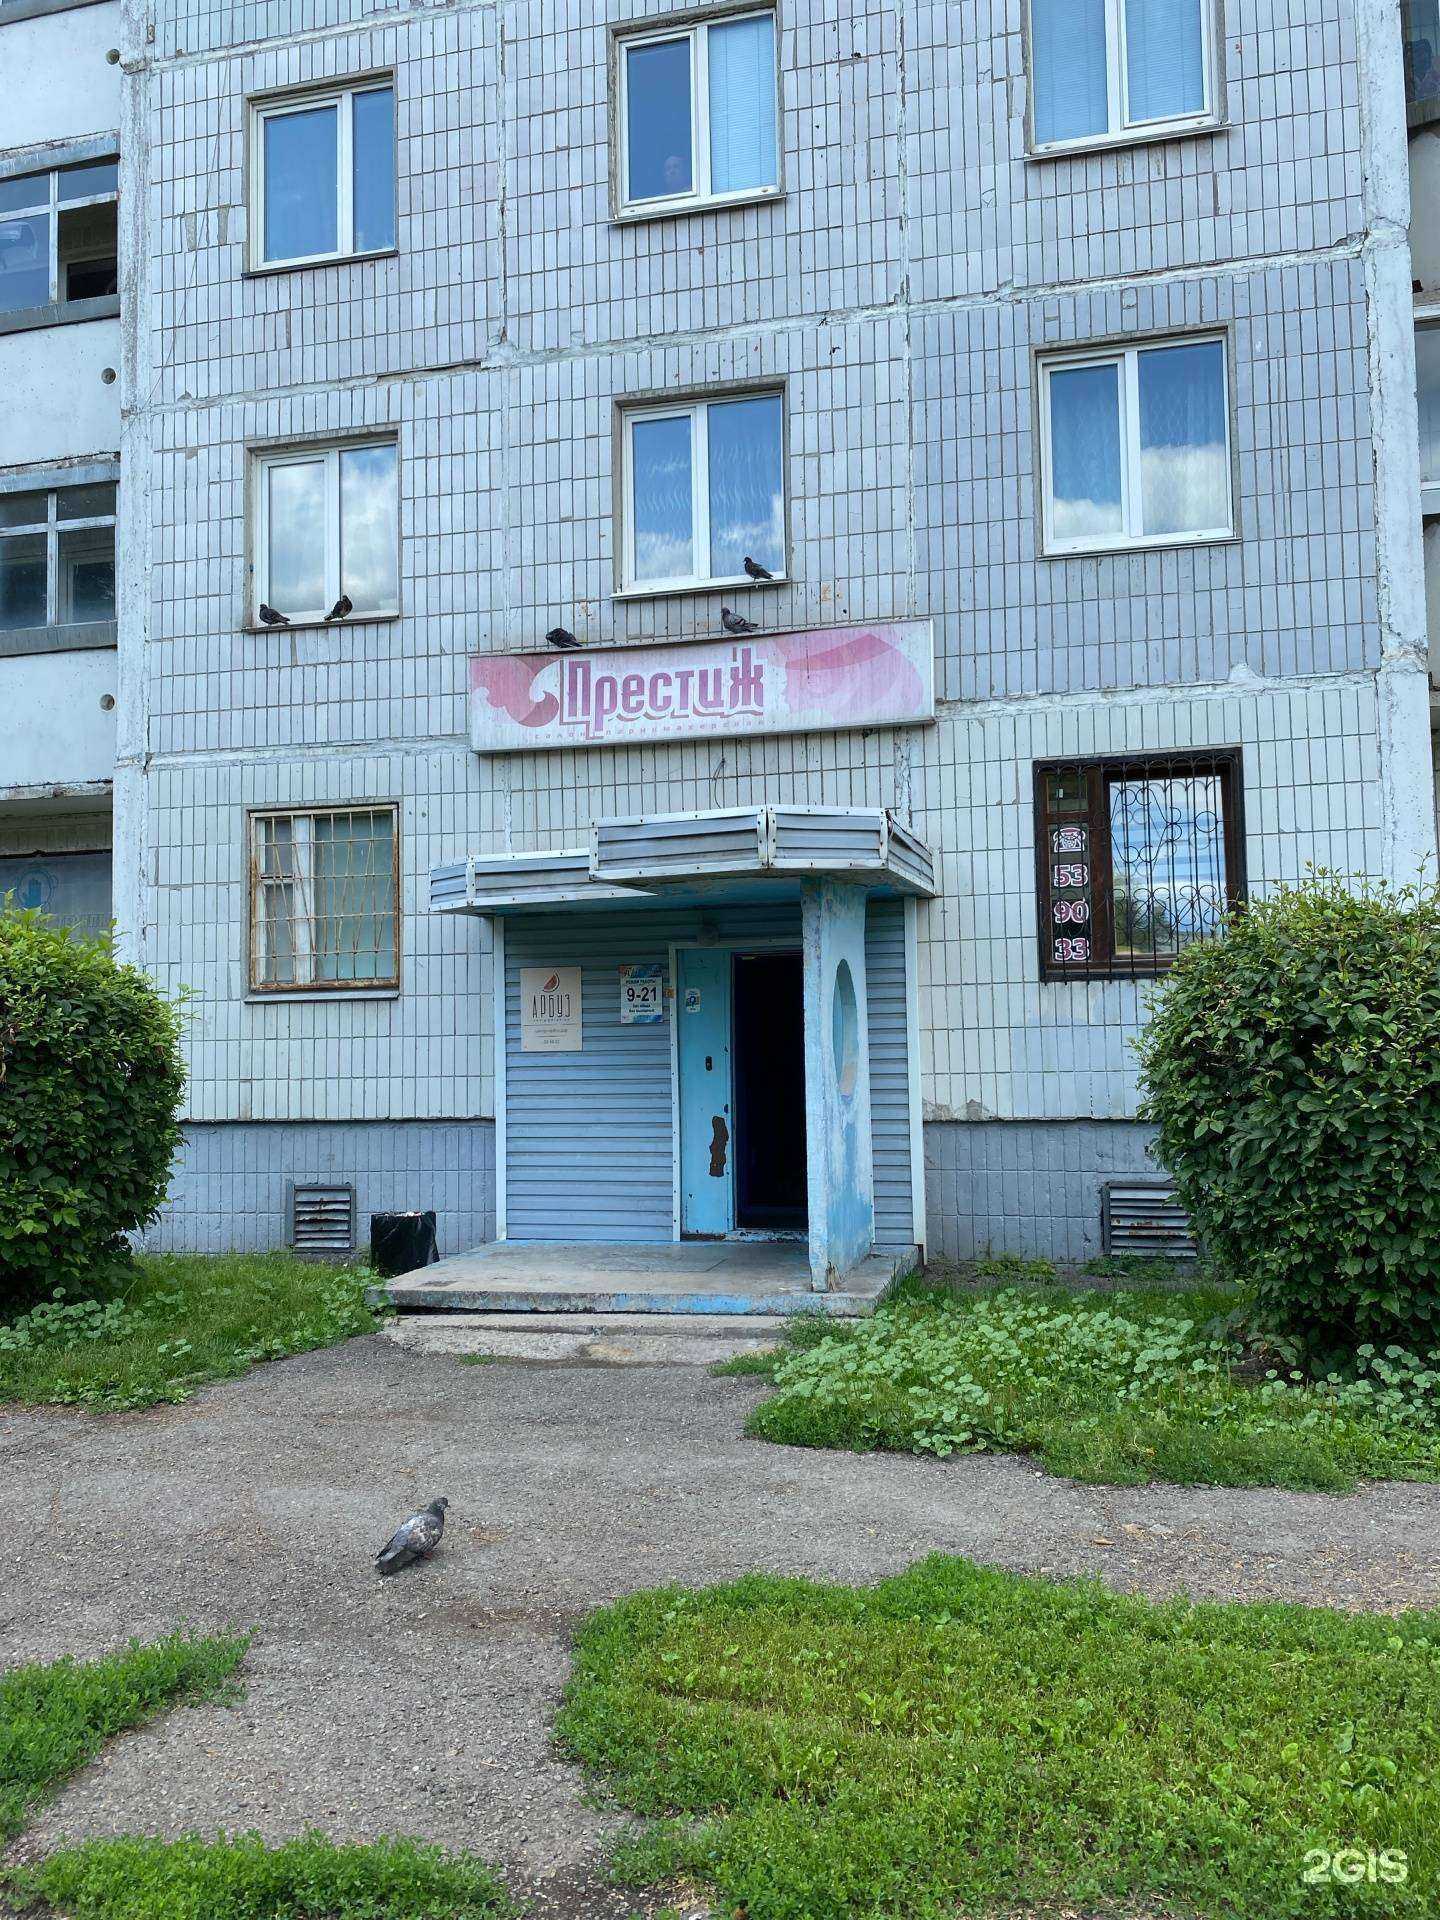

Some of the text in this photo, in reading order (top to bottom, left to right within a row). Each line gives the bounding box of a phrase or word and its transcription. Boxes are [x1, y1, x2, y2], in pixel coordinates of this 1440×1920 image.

[567, 647, 764, 732] Престиж
[1054, 864, 1088, 887] 53
[1054, 900, 1089, 923] 90
[1055, 938, 1089, 961] 33
[626, 986, 657, 1002] 9-21
[532, 993, 572, 1019] АРБУЗ
